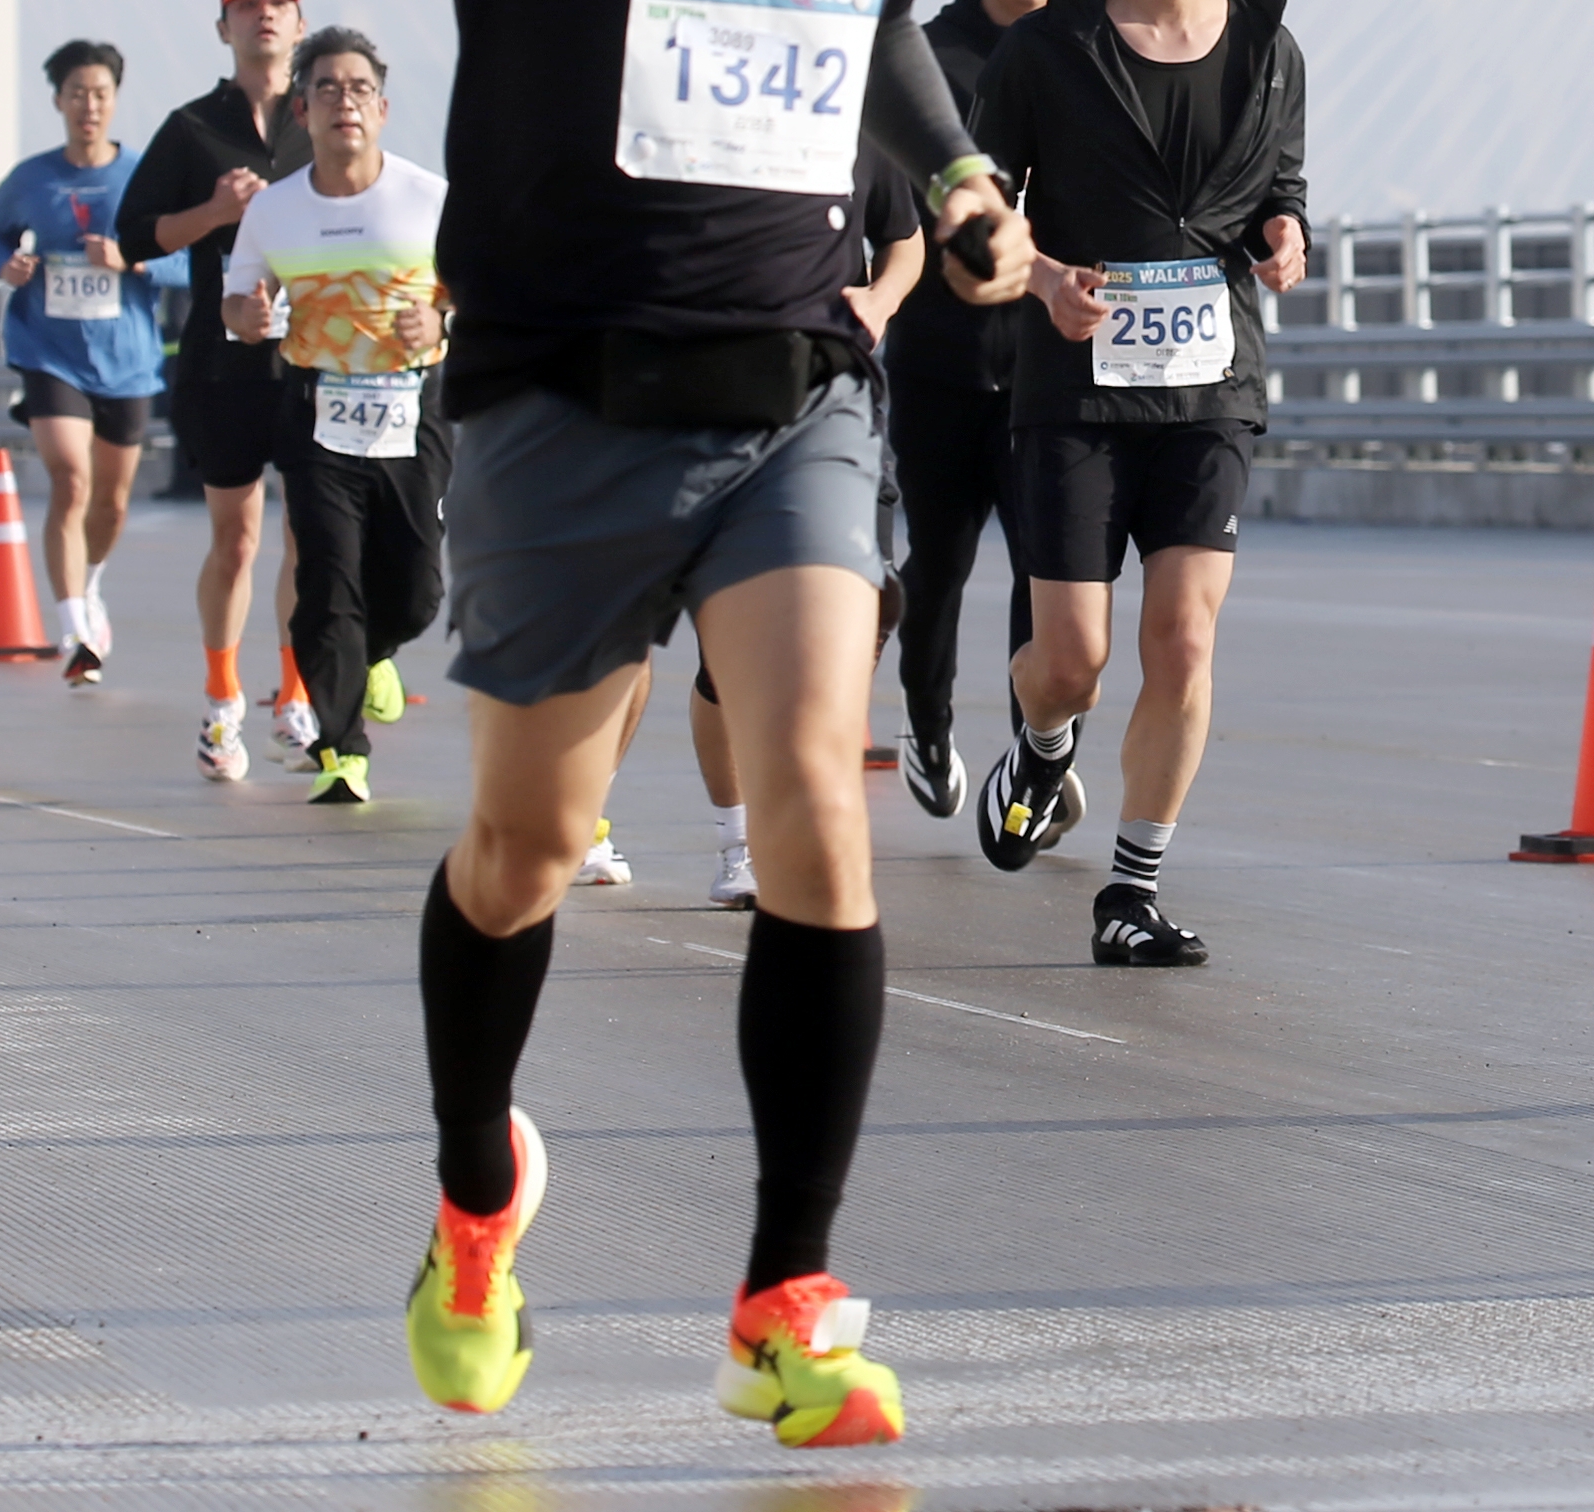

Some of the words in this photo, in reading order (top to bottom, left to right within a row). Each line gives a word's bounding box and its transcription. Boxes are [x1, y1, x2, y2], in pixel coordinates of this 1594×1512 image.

[665, 38, 848, 116] 1342
[53, 275, 110, 297] 2160
[1105, 271, 1133, 284] 2025
[1111, 303, 1217, 346] 2560
[329, 400, 406, 428] 2473
